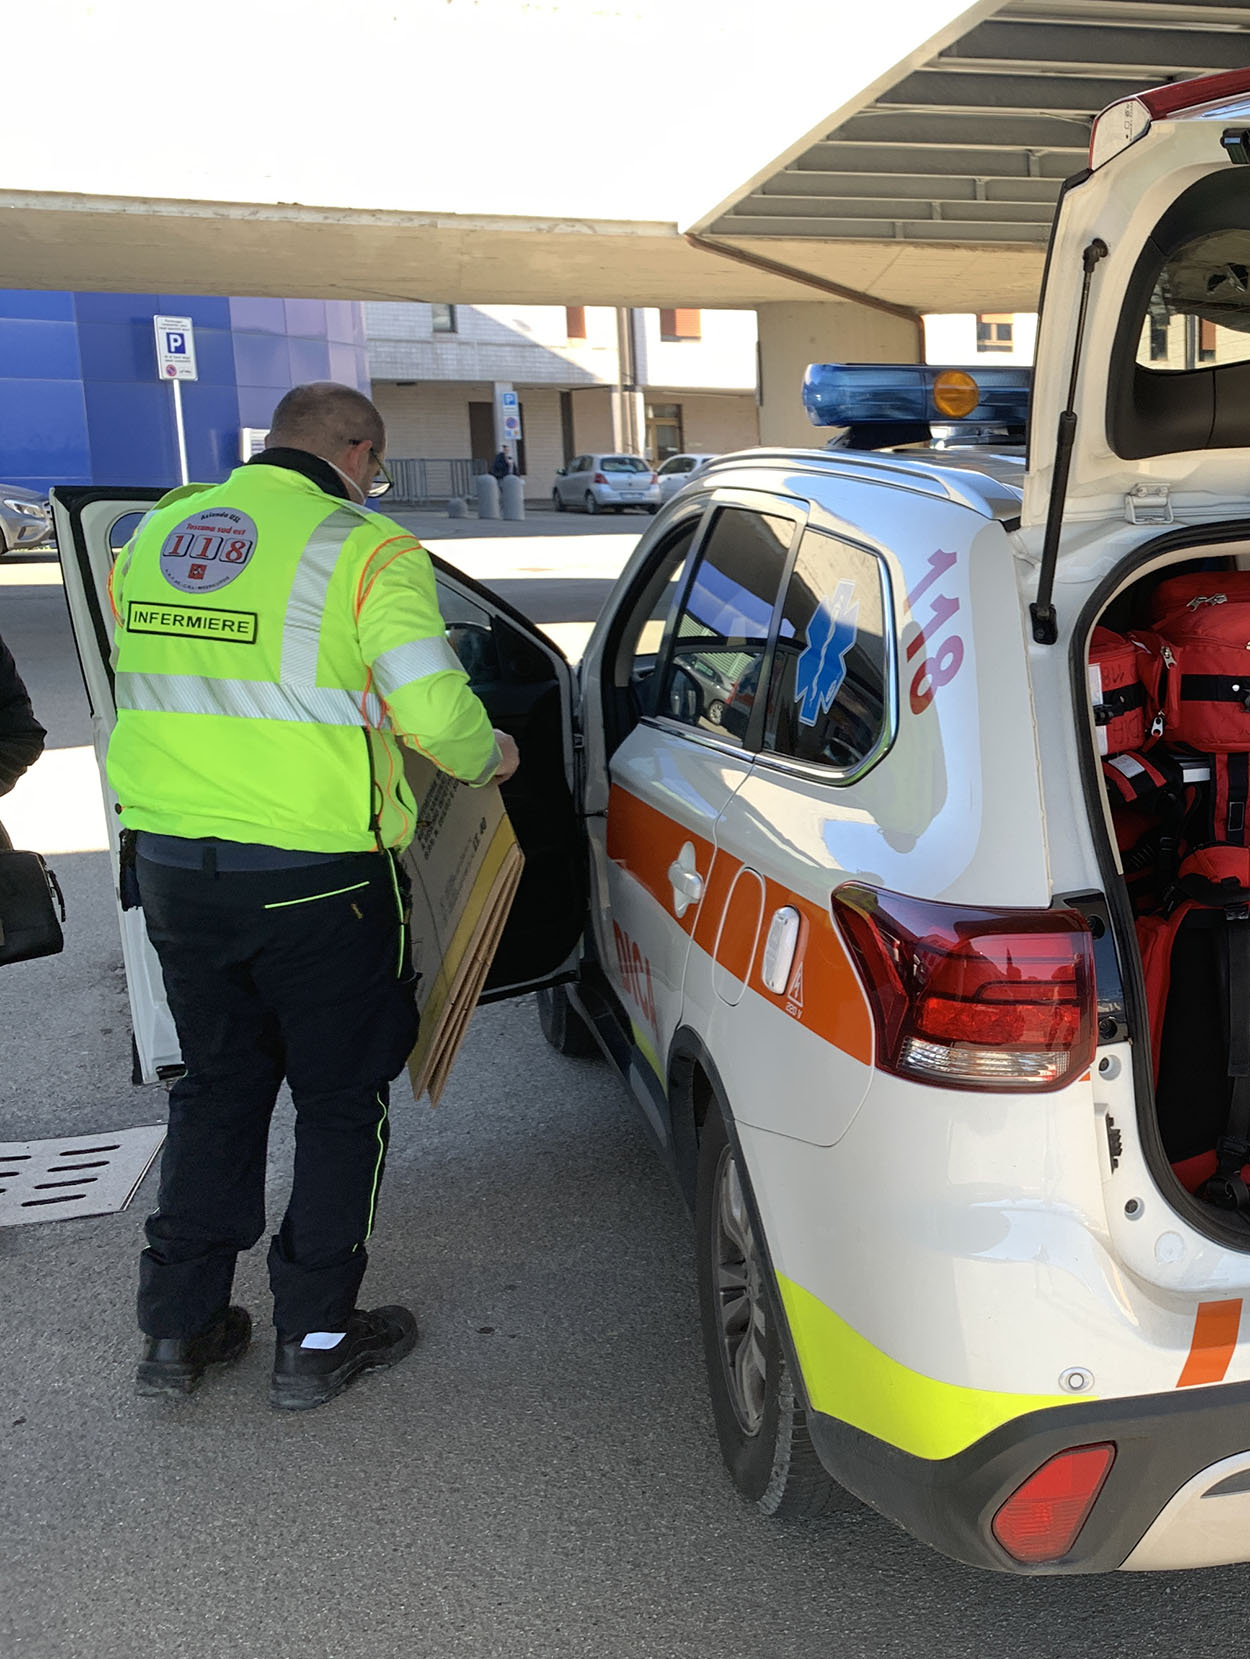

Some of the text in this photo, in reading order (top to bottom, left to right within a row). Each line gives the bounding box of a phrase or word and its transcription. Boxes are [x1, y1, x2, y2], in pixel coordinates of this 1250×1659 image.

[169, 334, 182, 352] P
[186, 523, 215, 532] Toscana
[217, 526, 232, 534] sud
[168, 535, 246, 562] 118
[133, 611, 250, 634] INFERMIERE
[903, 548, 964, 715] 118
